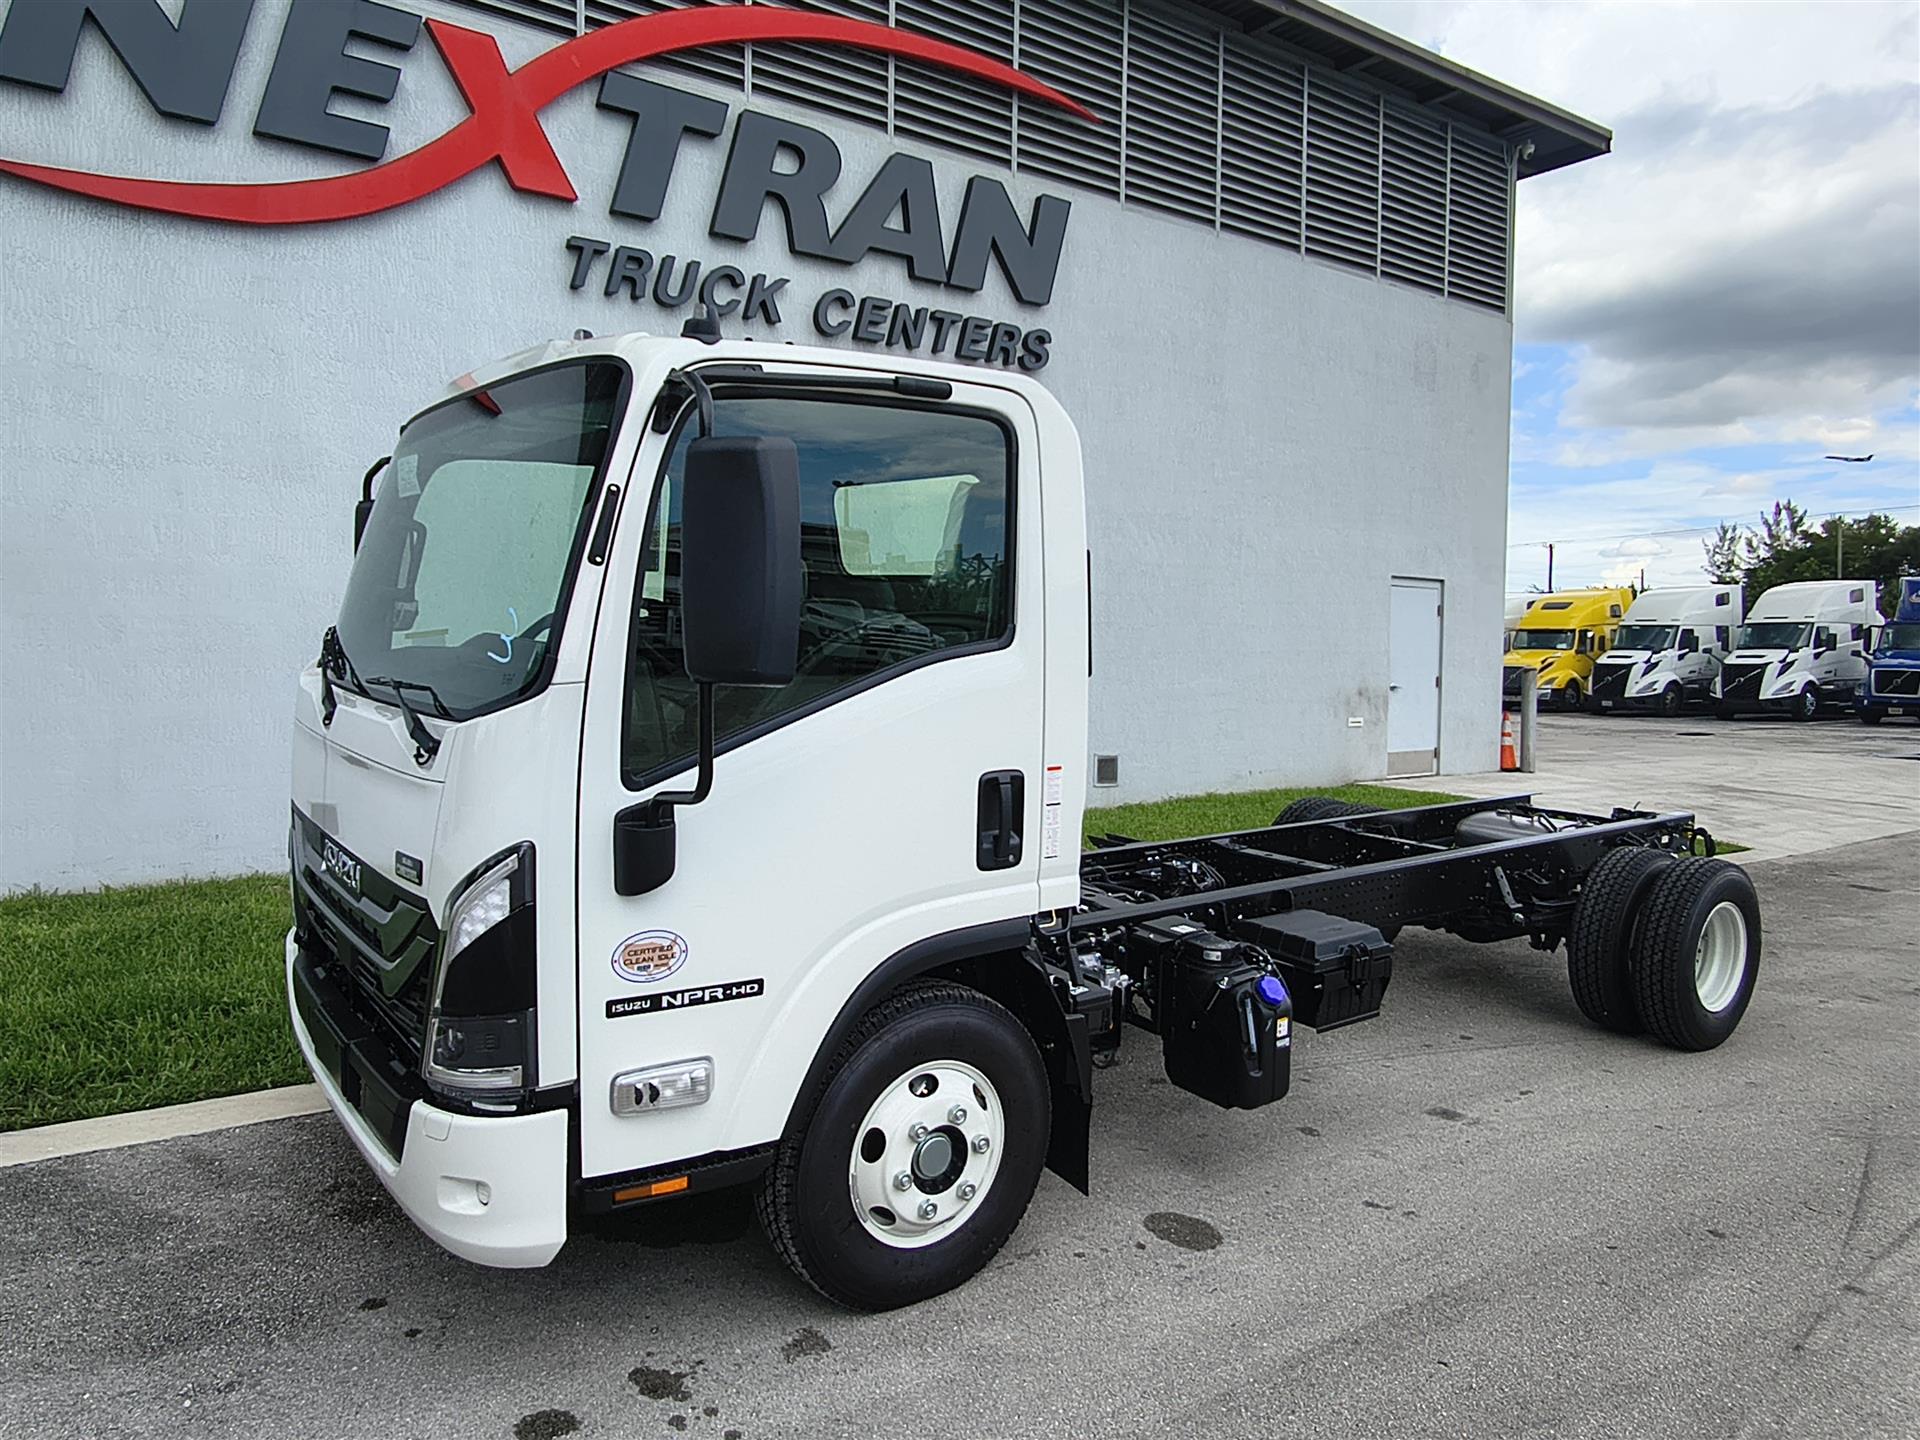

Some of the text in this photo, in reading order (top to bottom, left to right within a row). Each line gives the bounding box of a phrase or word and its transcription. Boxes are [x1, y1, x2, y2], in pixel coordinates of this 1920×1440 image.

[0, 0, 1072, 306] NEXTRAN
[565, 235, 1053, 371] TRUCK CENTERS
[623, 955, 654, 966] CLEAN
[658, 951, 677, 961] IDLE
[627, 944, 674, 957] CERTIFIED
[612, 983, 759, 1013] ISUZU NPR-HD
